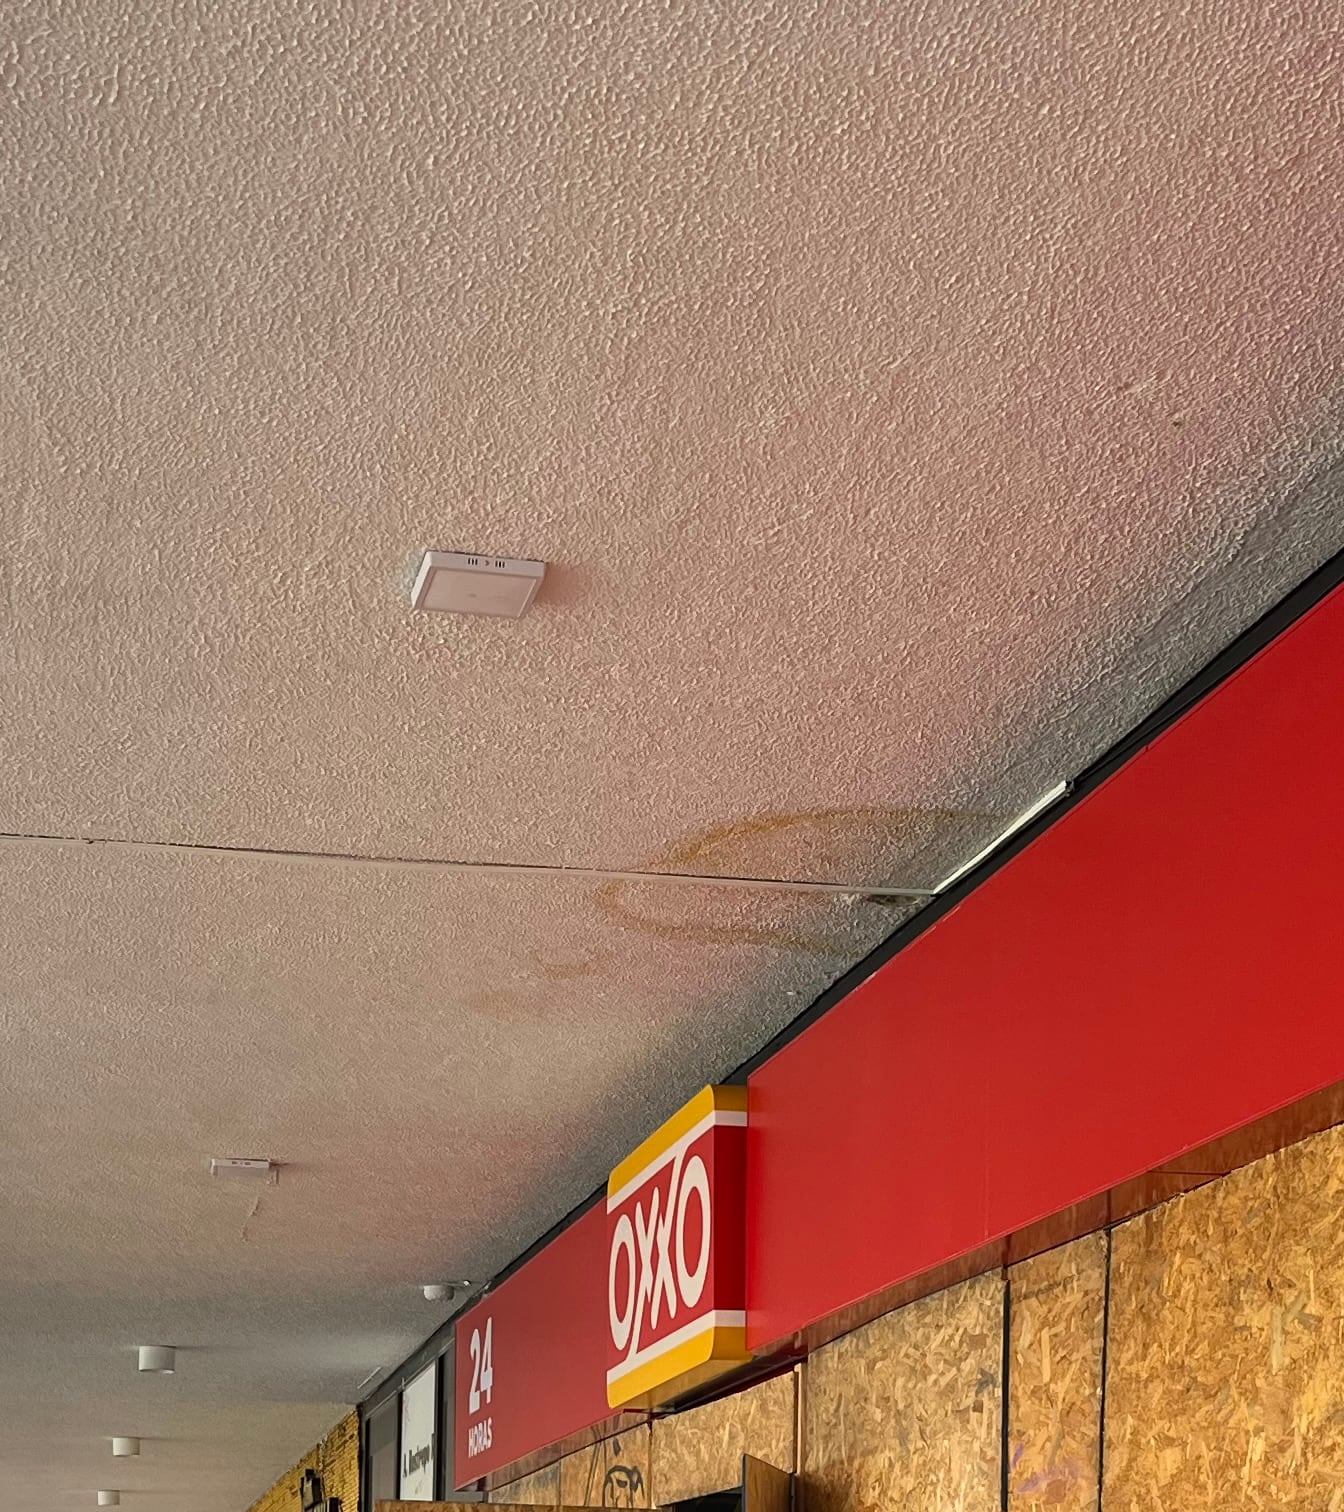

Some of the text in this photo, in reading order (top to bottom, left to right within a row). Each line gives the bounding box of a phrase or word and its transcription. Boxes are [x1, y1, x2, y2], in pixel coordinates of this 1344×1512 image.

[608, 1152, 712, 1352] OXXO
[469, 1316, 493, 1415] 24
[468, 1417, 493, 1458] HORAS
